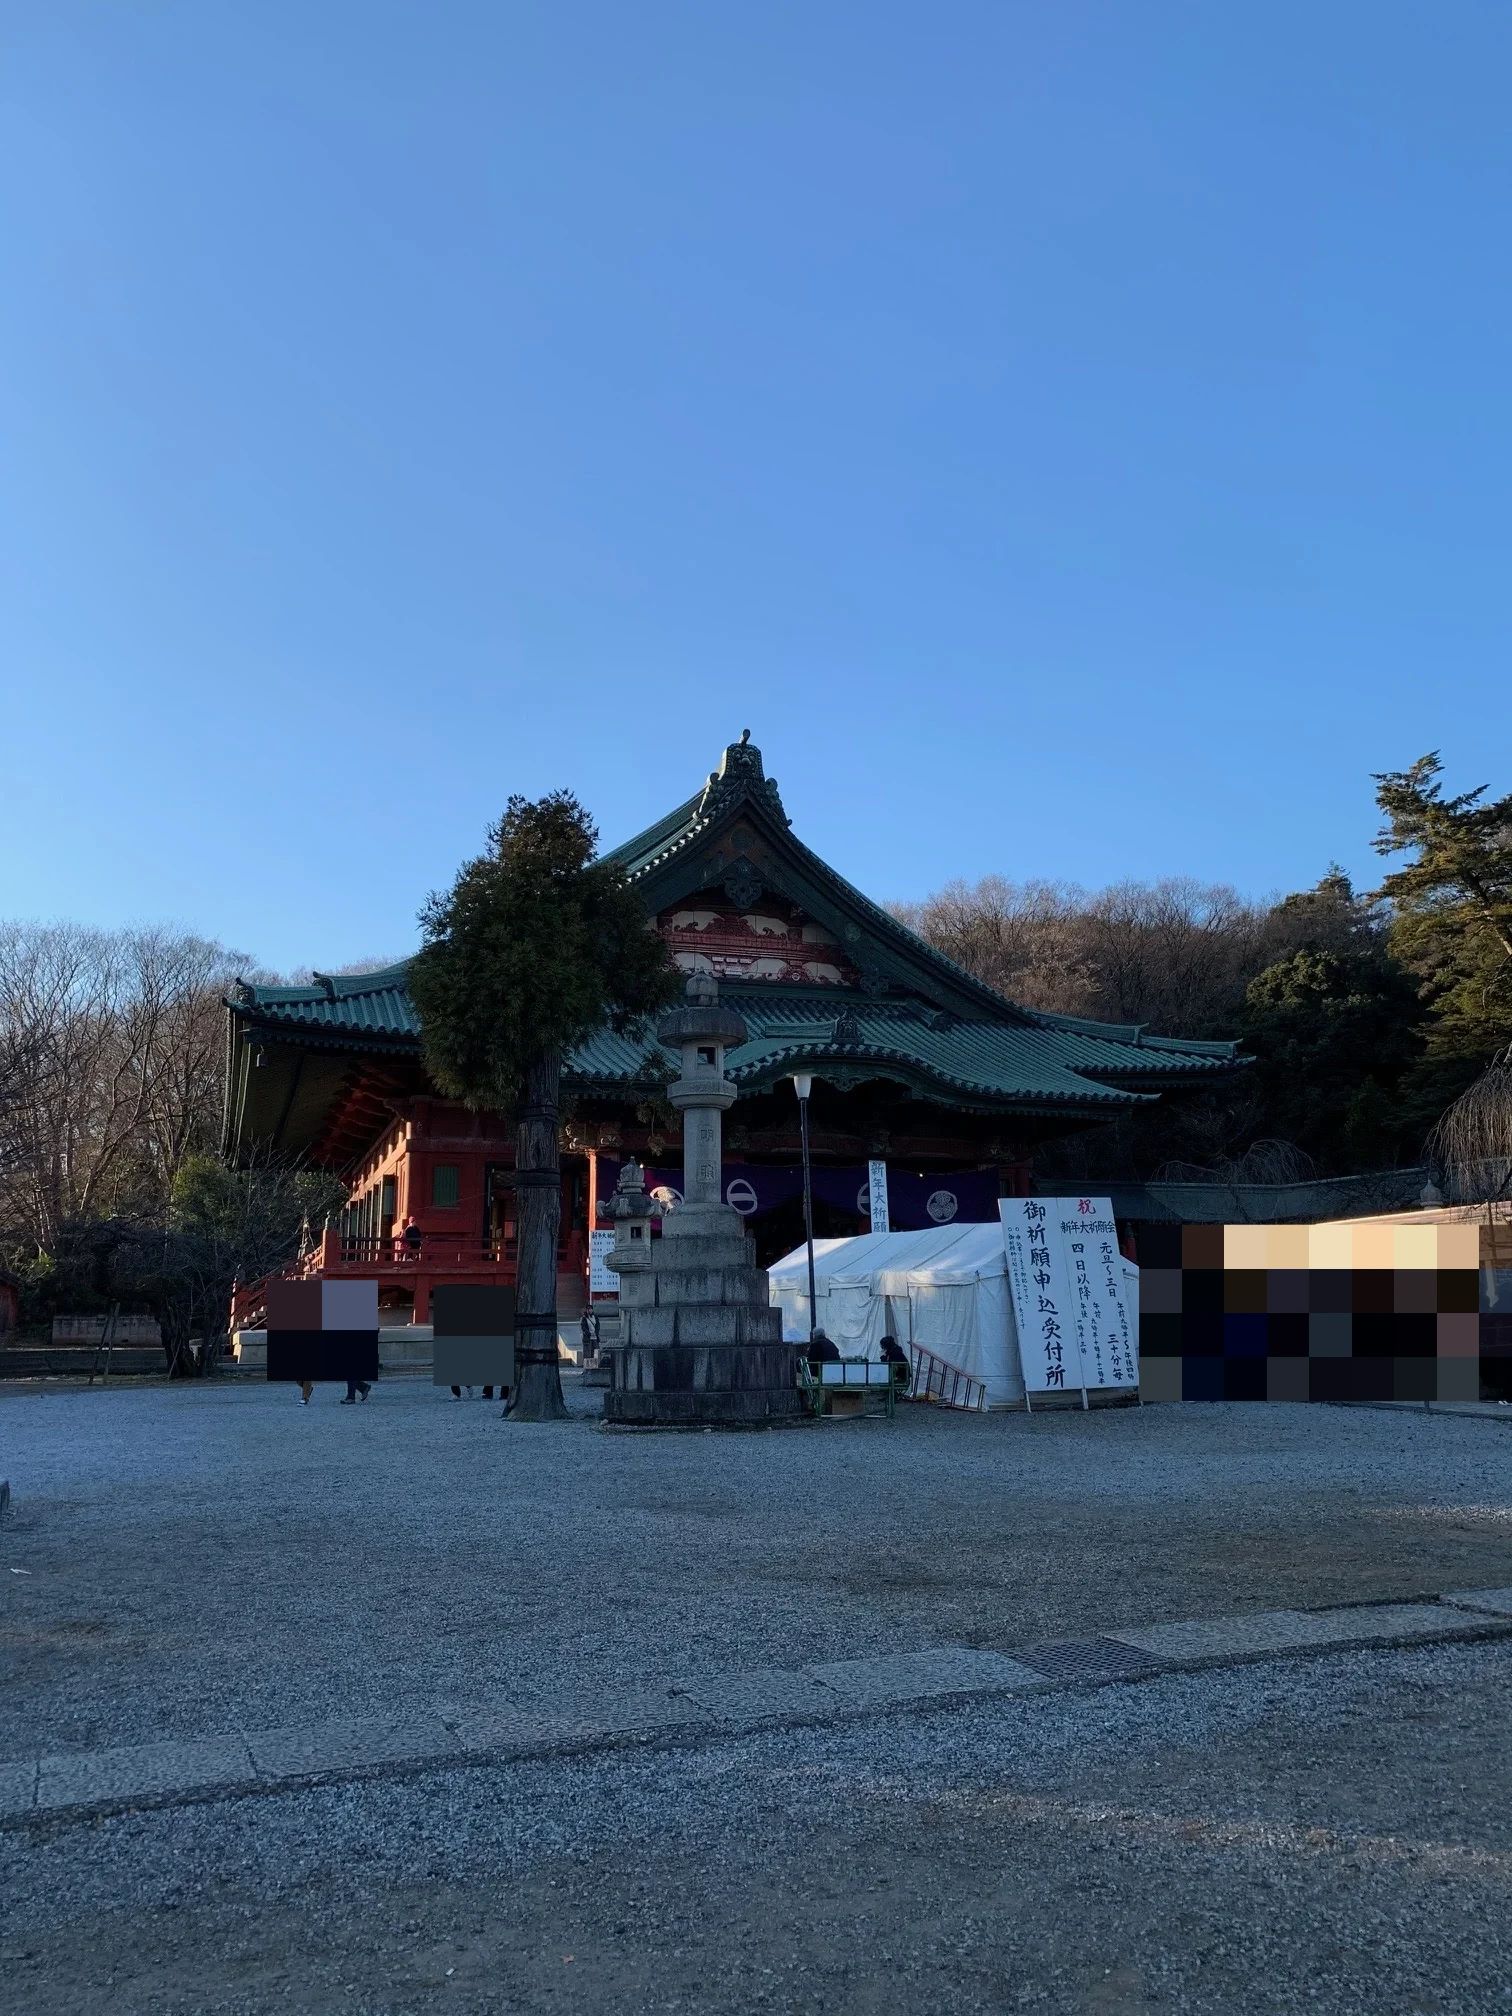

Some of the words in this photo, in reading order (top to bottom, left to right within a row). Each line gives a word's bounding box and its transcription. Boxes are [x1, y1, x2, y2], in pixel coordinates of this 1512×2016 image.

[1060, 1220, 1116, 1235] 新年大祈願会
[1077, 1199, 1096, 1215] 祝
[1023, 1200, 1066, 1388] 御祈願申込受付所
[1071, 1243, 1092, 1300] 四日以降
[1107, 1334, 1123, 1381] 三十分毎
